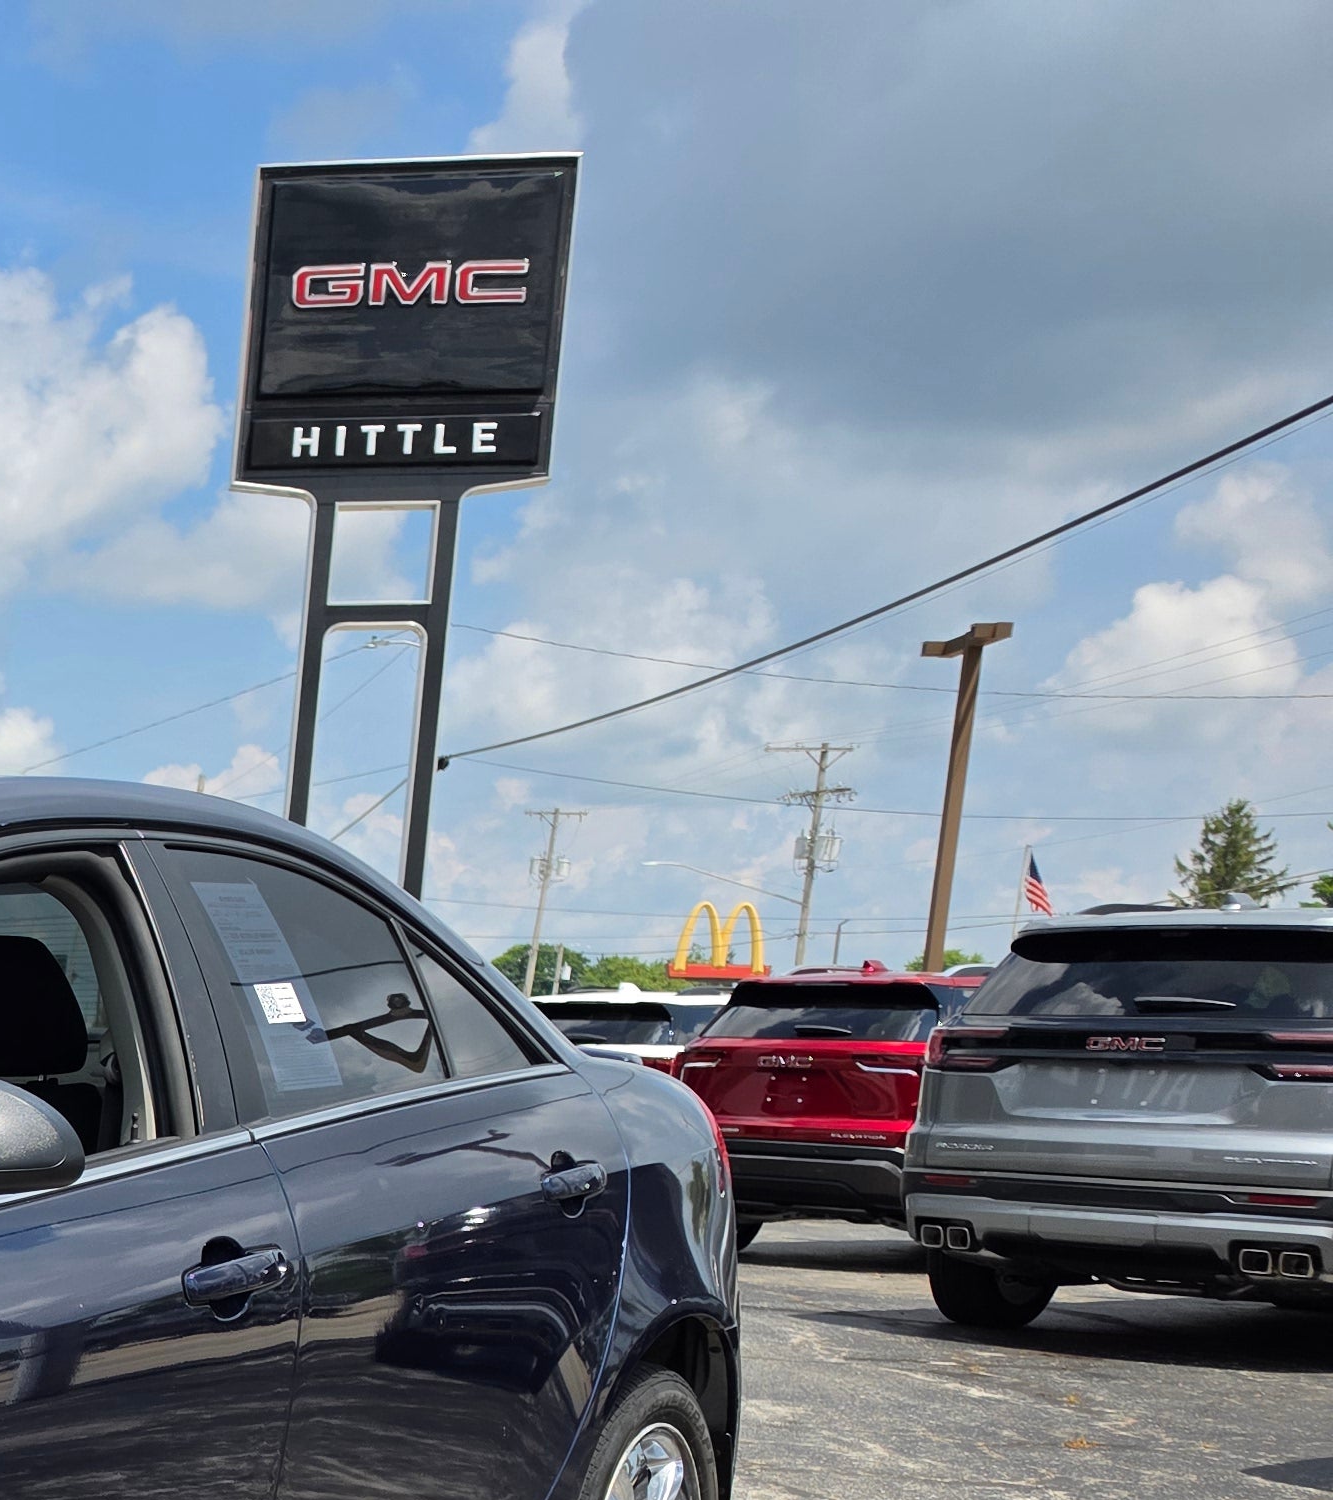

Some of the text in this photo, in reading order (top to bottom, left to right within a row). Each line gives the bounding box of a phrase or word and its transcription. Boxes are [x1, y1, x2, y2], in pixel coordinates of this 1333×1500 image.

[292, 259, 530, 308] GMC
[291, 422, 498, 458] HITTLE
[1085, 1036, 1166, 1053] GMC
[757, 1055, 813, 1069] GMC
